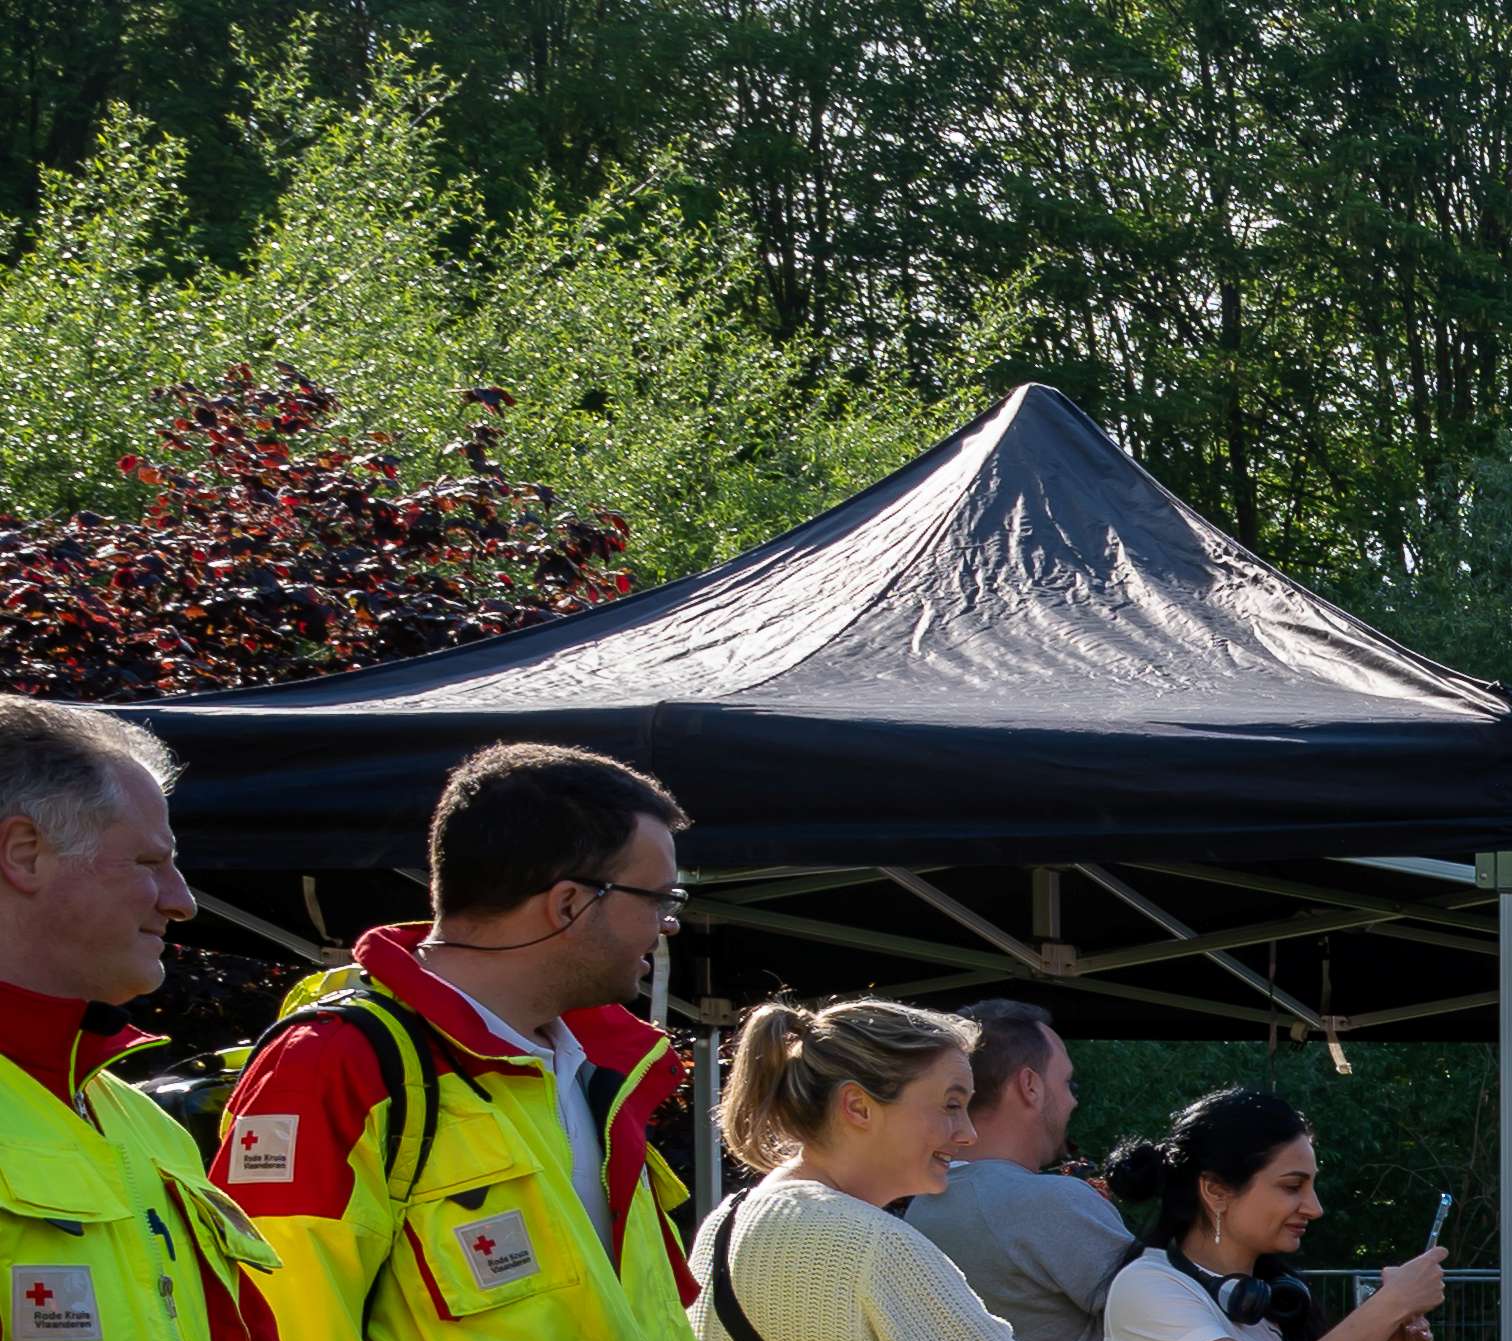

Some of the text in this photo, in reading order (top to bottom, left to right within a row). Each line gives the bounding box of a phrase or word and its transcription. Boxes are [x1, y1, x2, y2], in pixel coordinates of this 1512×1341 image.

[33, 1311, 91, 1320] Rode Kruis
[34, 1319, 92, 1329] Vlaanderen
